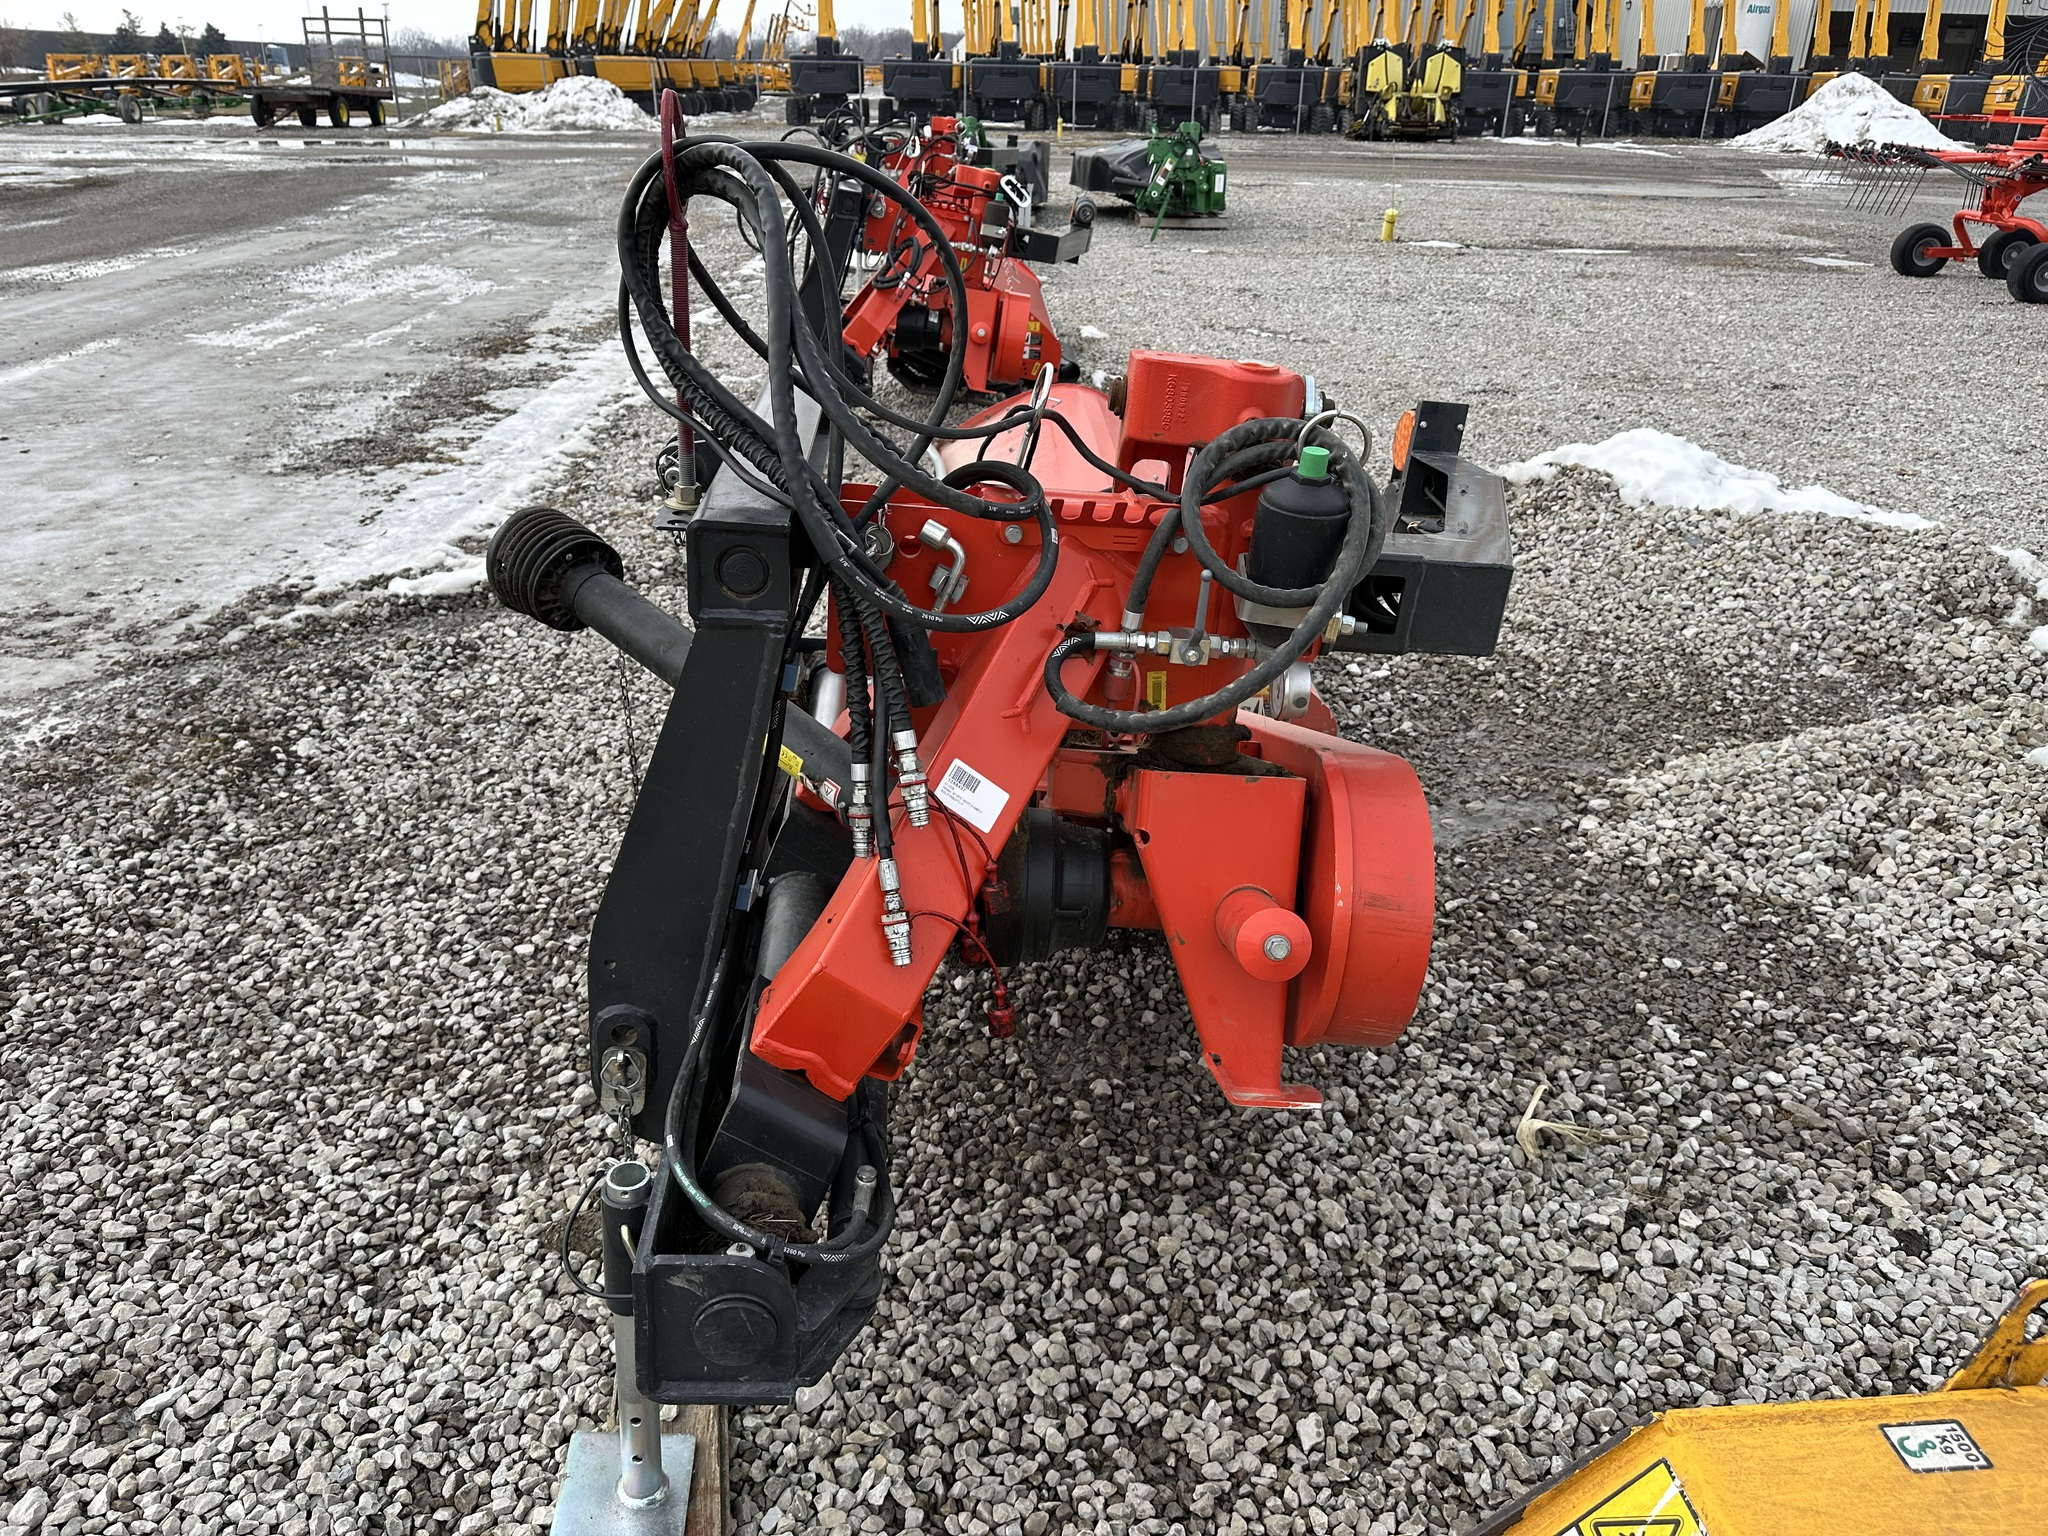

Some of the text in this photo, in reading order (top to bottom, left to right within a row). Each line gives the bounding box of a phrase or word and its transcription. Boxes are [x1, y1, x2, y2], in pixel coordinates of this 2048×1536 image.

[1746, 4, 1771, 14] Airgas
[921, 612, 935, 621] 2610
[783, 1246, 806, 1258] 3260 Psi
[1945, 1426, 1980, 1462] 1500
